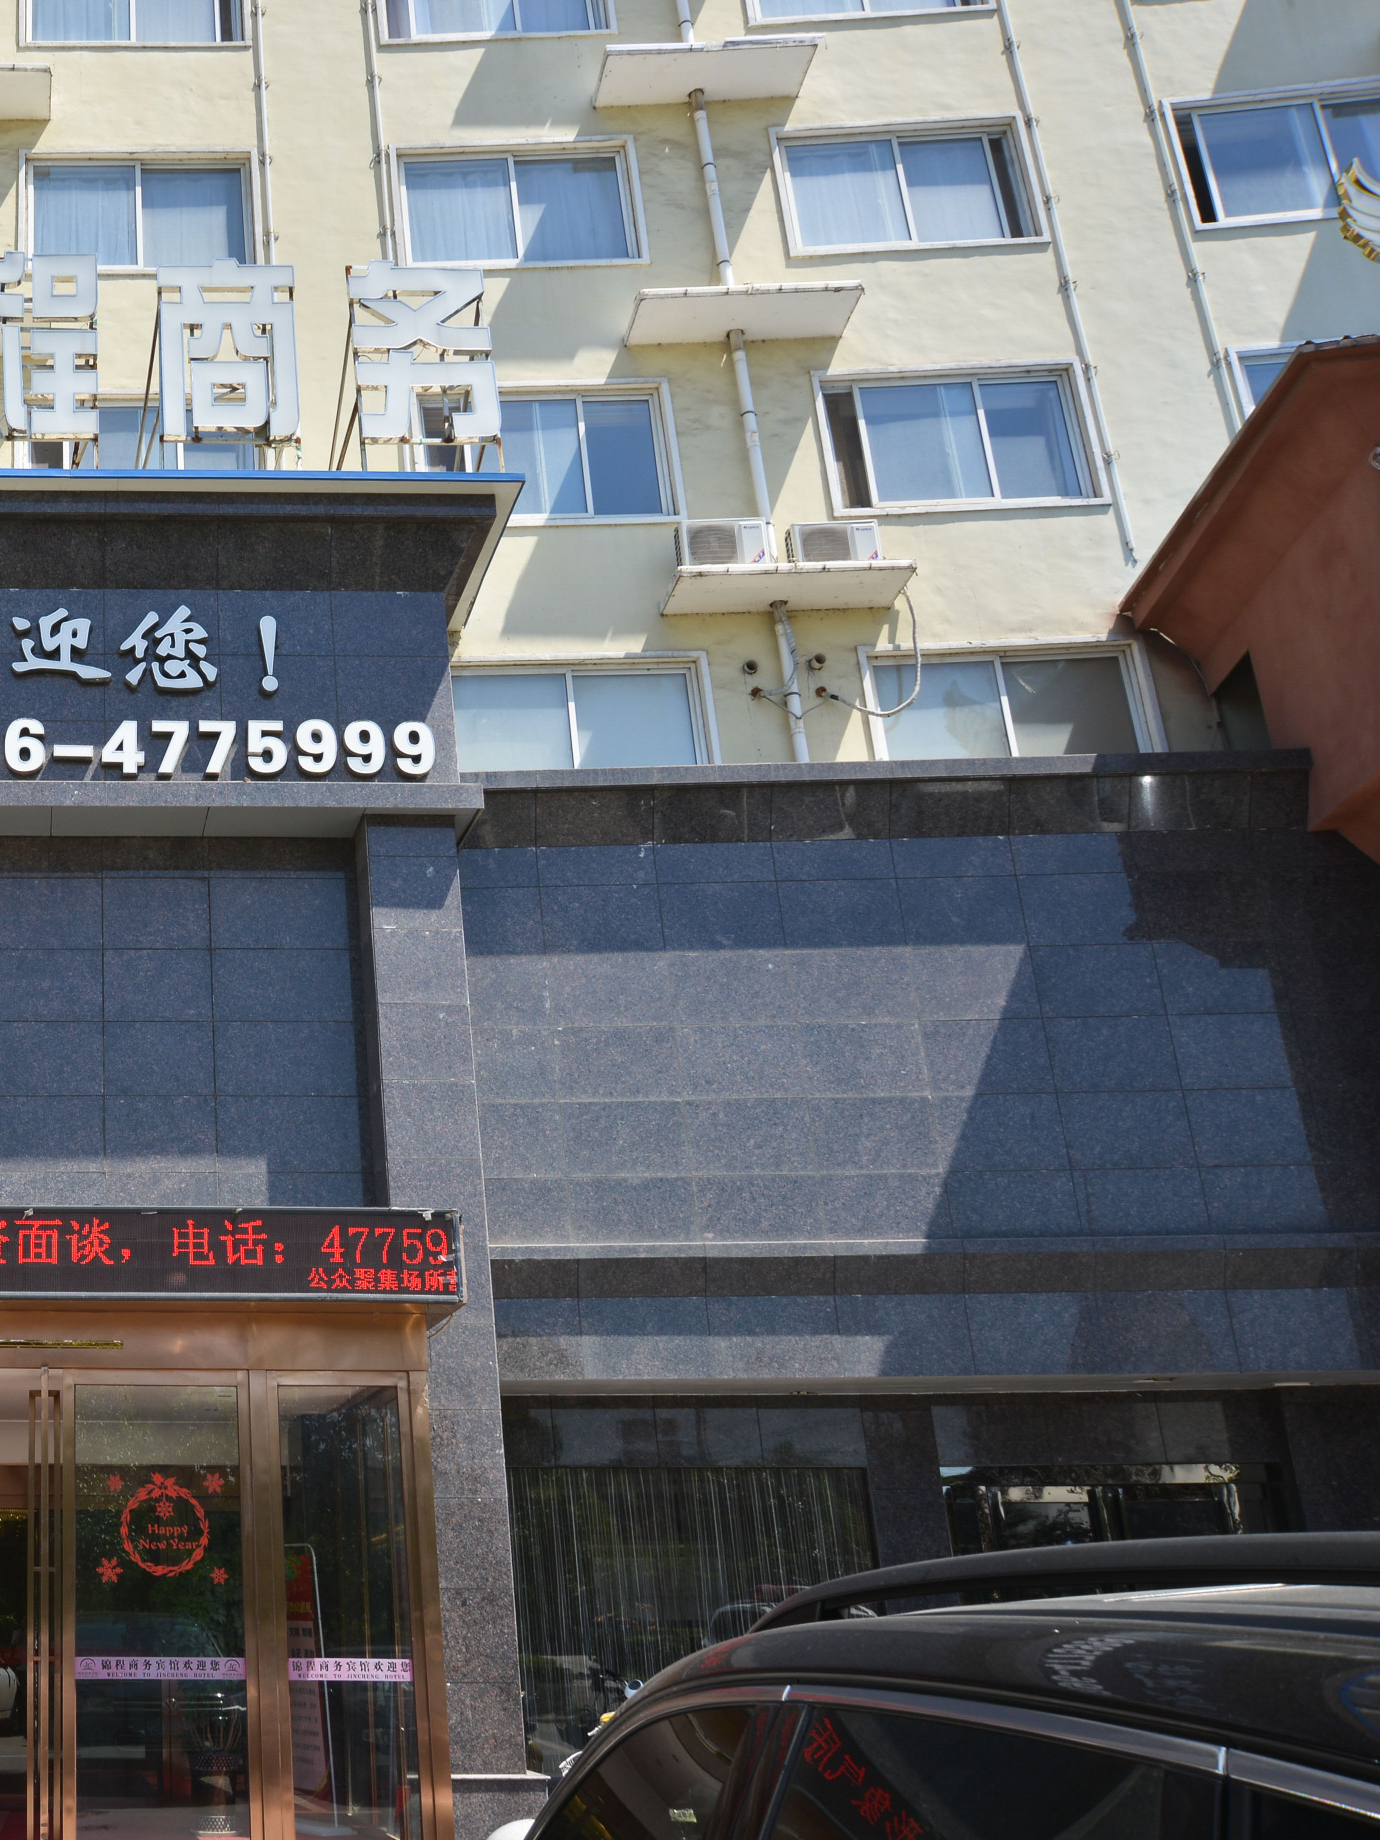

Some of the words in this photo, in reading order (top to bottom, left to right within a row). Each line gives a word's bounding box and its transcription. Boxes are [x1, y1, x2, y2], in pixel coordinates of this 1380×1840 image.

[148, 1523, 188, 1537] Happy
[139, 1539, 167, 1549] New
[170, 1538, 199, 1549] Year
[101, 1658, 221, 1671] 锦程商务宾馆欢迎您
[292, 1660, 411, 1673] 锦程商务宾馆欢迎您
